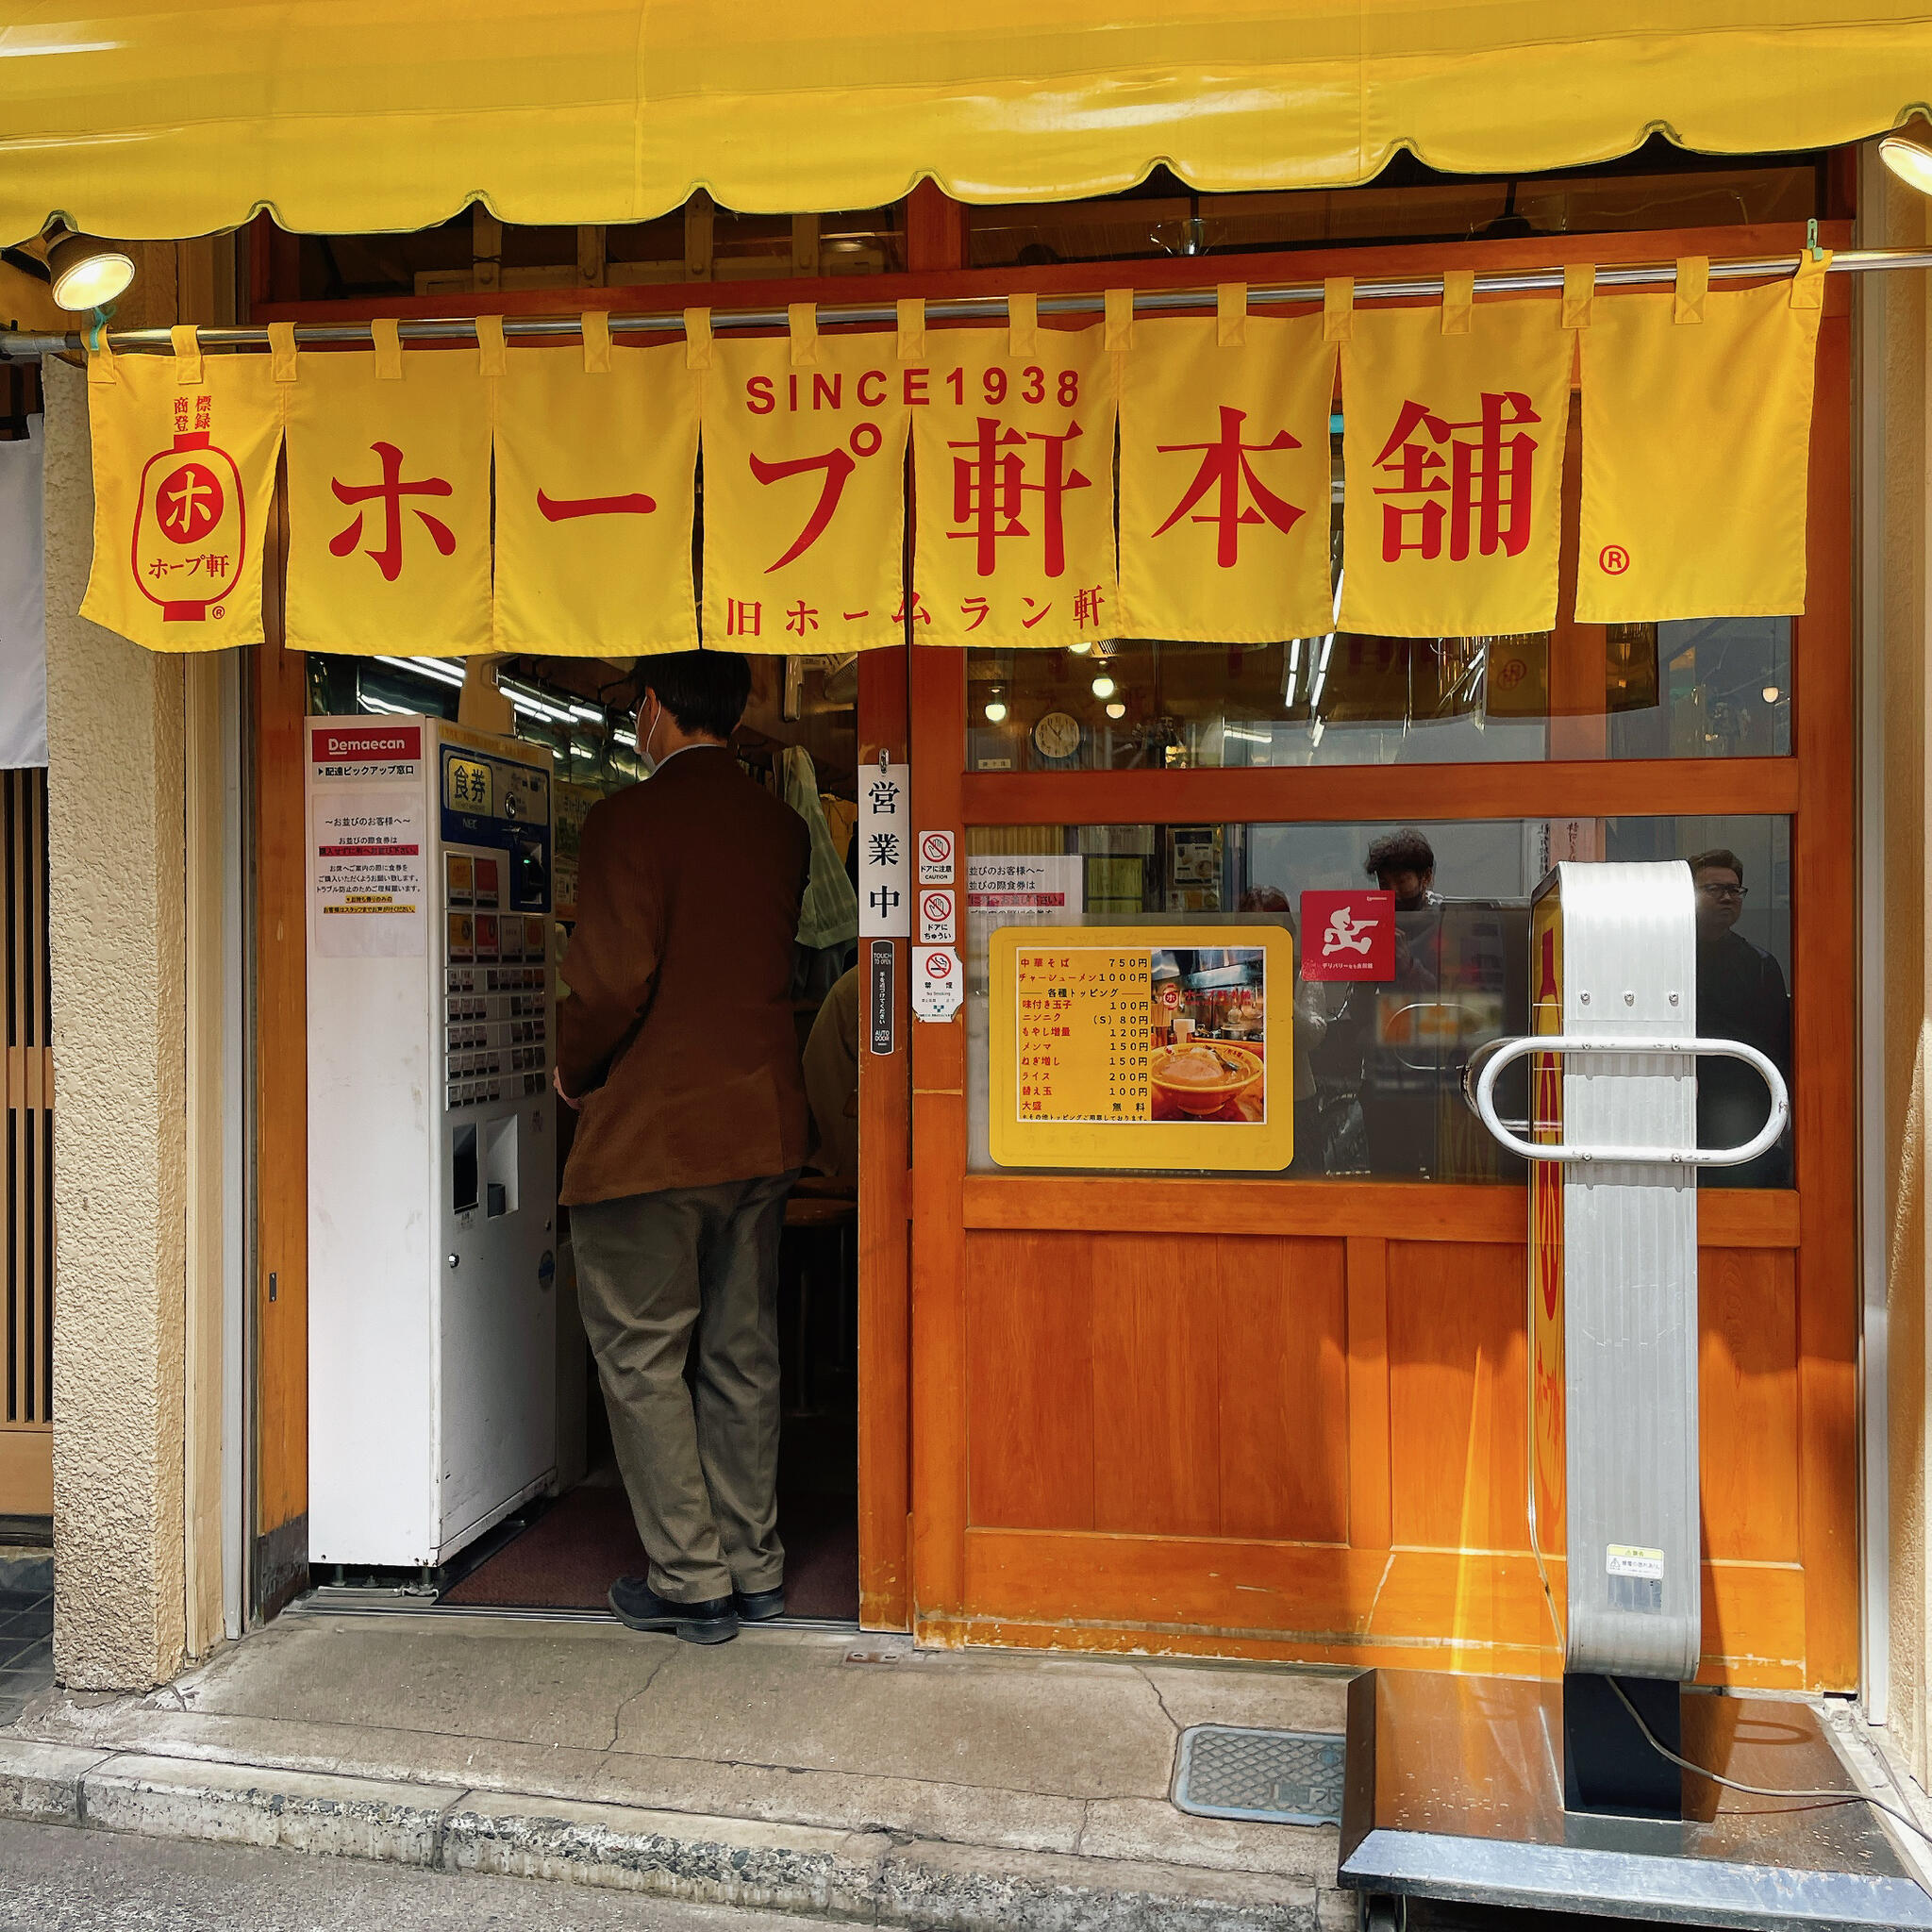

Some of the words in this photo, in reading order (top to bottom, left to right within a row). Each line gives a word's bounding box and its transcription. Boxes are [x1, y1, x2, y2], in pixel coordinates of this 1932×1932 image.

[328, 391, 1543, 582] ホープ軒本舗
[165, 470, 213, 534] ホ
[148, 553, 230, 579] ホープ軒
[725, 585, 1105, 638] 旧ホームラン軒
[327, 738, 406, 755] Demaecan
[325, 765, 414, 776] 配達ピックアップ窓口
[453, 765, 486, 803] 食券
[868, 781, 900, 919] 営業中
[1021, 958, 1070, 968] 中華そば
[1108, 958, 1147, 968] 750円
[1099, 974, 1147, 982] 1000円
[1048, 988, 1119, 998] 各種トッピング
[1022, 1000, 1072, 1009] 味付き玉子
[1109, 1002, 1148, 1010] 100円
[1022, 1026, 1071, 1037] もやし増量
[1109, 1028, 1148, 1037] 120円
[1023, 1042, 1052, 1051] メンマ
[1109, 1042, 1148, 1052] 150円
[1022, 1057, 1060, 1065] ねぎ増し
[1109, 1057, 1147, 1066] 150円
[1023, 1072, 1050, 1081] ライス
[1109, 1073, 1147, 1082] 200円
[1023, 1086, 1052, 1095] 替え玉
[1109, 1088, 1147, 1096] 100円
[1022, 1101, 1041, 1111] 大盛
